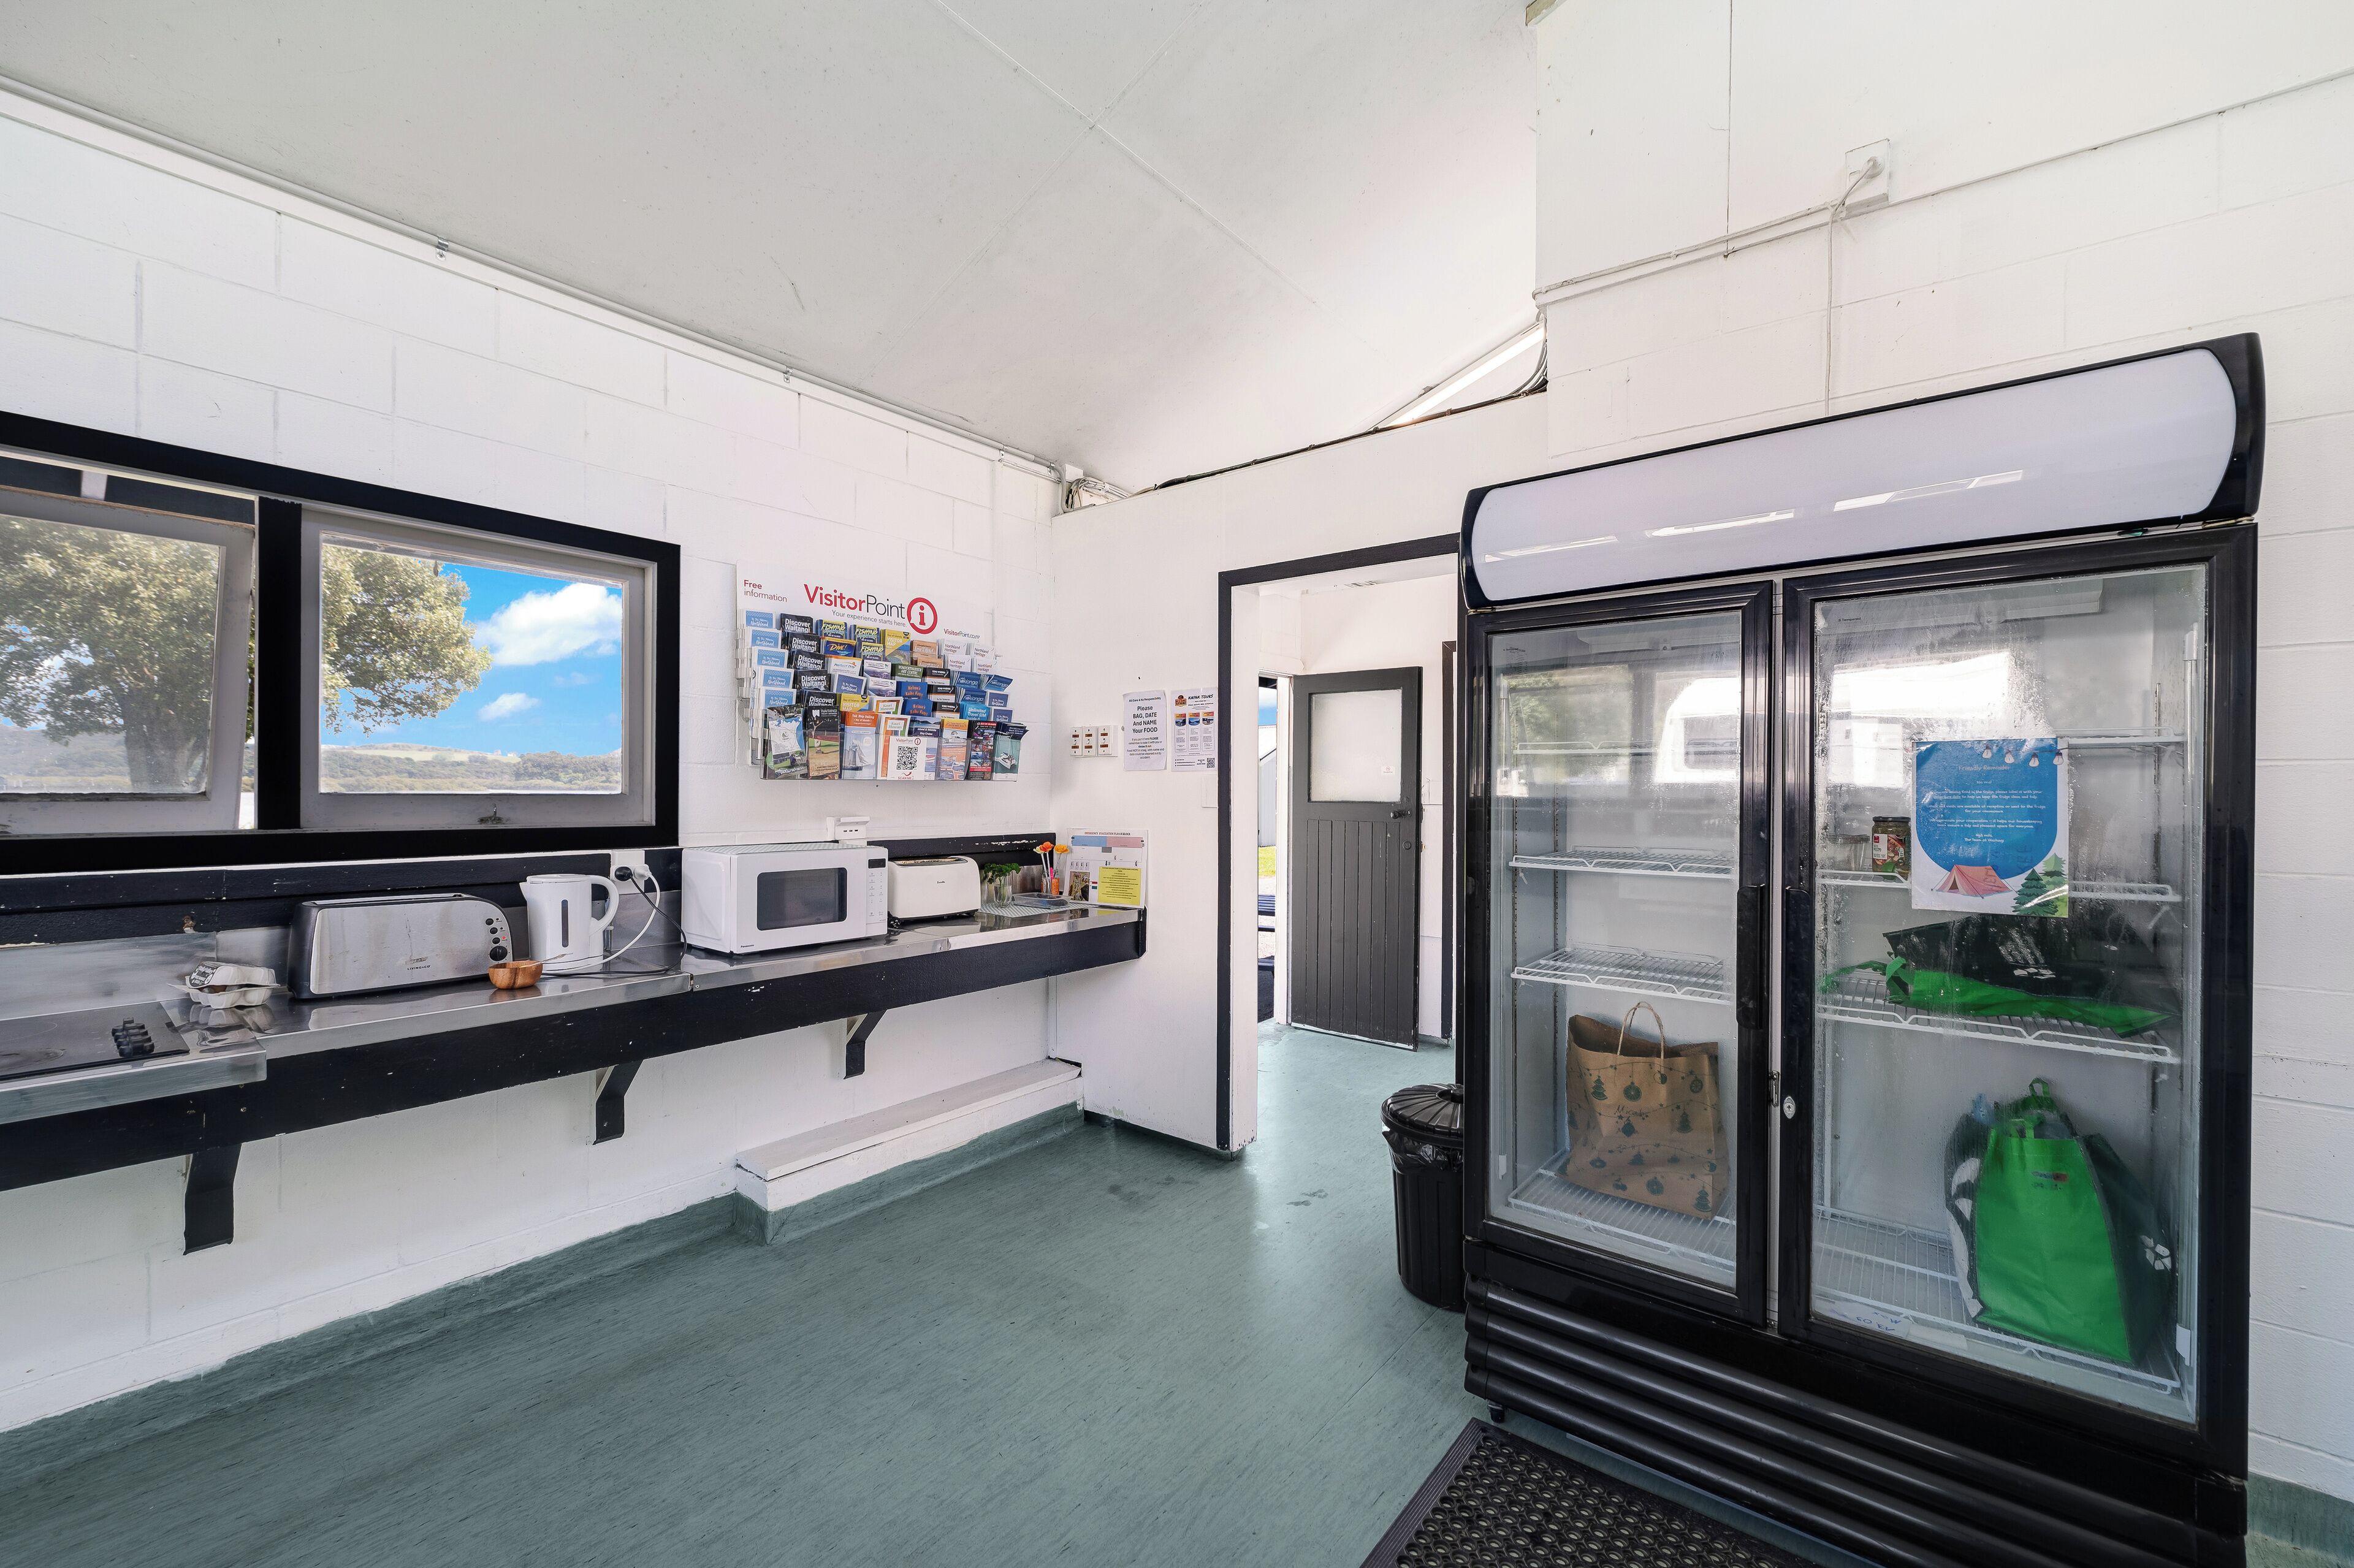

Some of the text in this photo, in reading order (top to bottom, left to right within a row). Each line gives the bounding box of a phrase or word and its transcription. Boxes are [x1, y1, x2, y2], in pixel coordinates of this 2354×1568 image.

[744, 580, 762, 589] Free
[744, 588, 787, 603] information
[804, 584, 905, 619] VisitorPoint
[785, 618, 810, 628] Discover
[847, 614, 877, 623] experience
[785, 624, 810, 633] Waitangi
[792, 637, 817, 646] Discover
[792, 643, 817, 652] Waitangi
[798, 655, 823, 664] Discover
[797, 660, 822, 669] Waitangi
